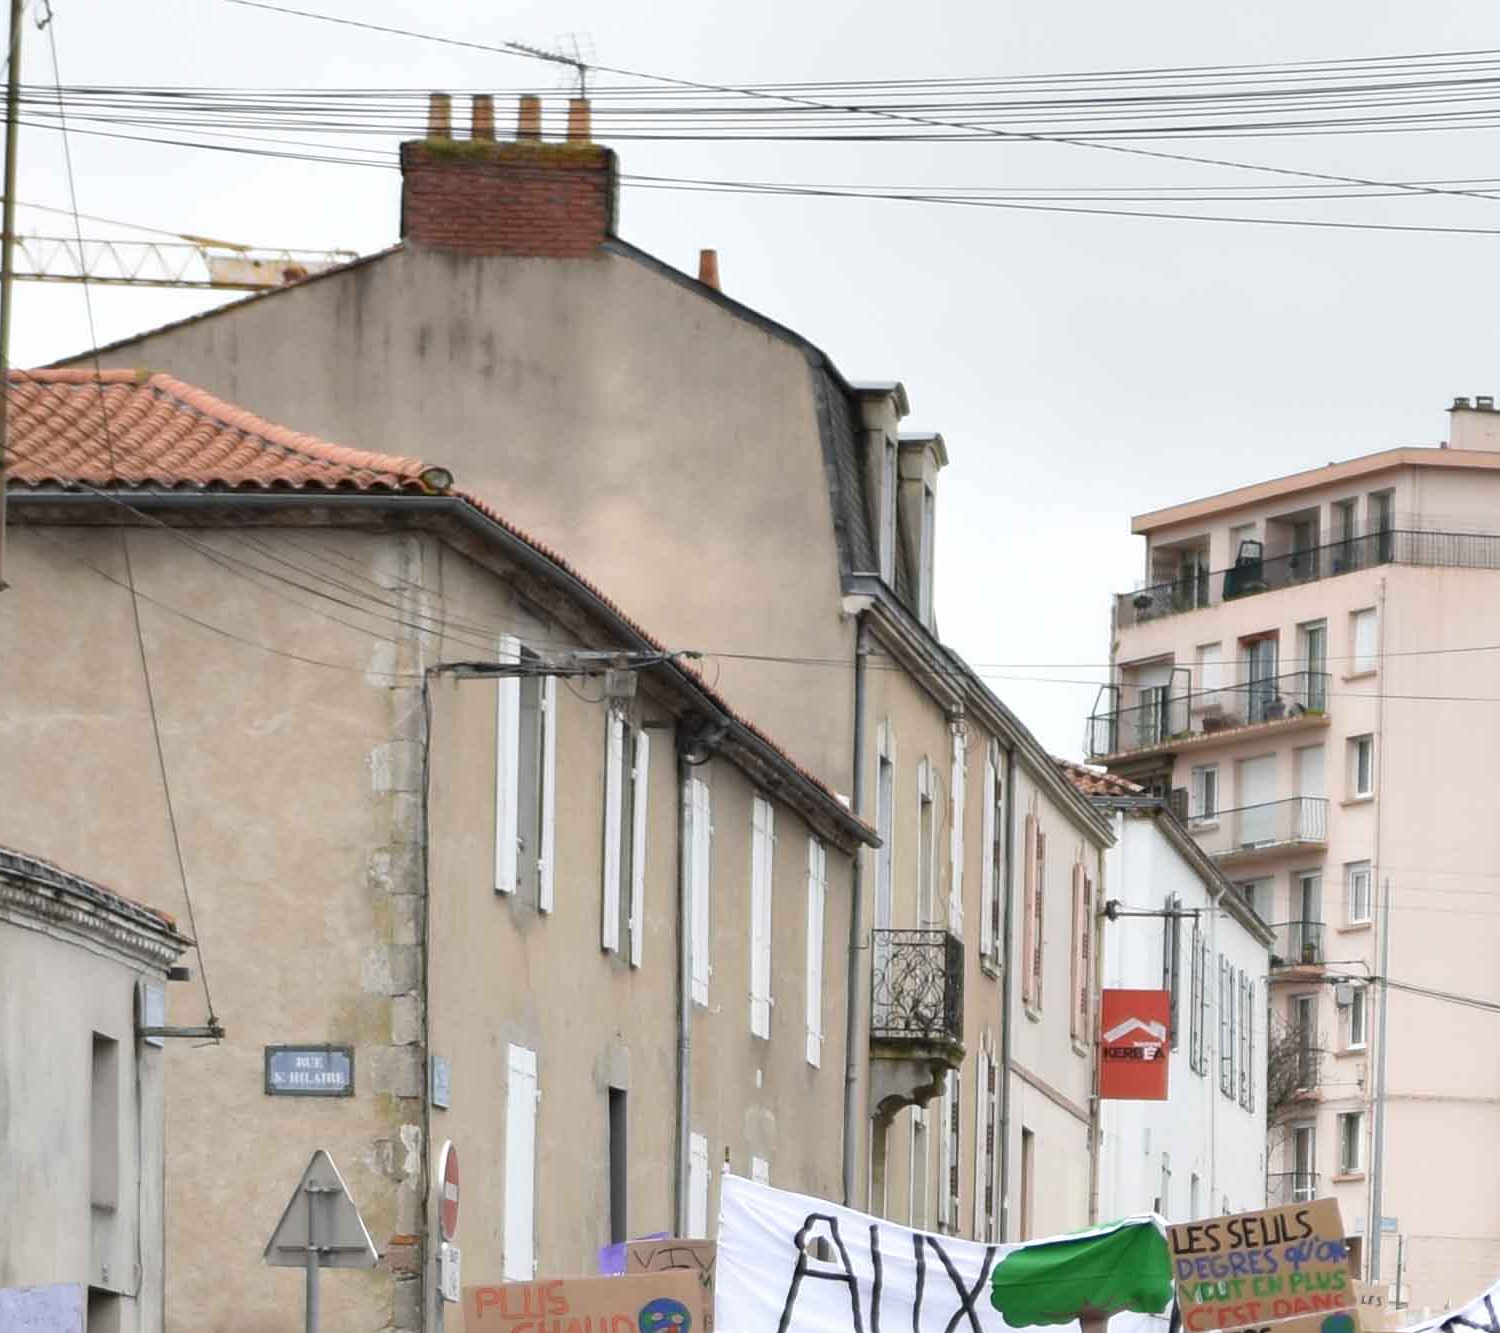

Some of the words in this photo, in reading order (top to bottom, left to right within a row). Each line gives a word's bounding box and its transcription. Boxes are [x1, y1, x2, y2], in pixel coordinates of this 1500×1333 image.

[295, 1056, 325, 1069] RUE
[1171, 1224, 1221, 1254] LES
[1227, 1210, 1313, 1250] SEULS
[1176, 1248, 1279, 1281] DEGRES
[1252, 1277, 1283, 1297] EN
[1290, 1269, 1347, 1294] PLUS
[475, 1280, 570, 1320] PLUS
[1186, 1301, 1261, 1331] C'EST
